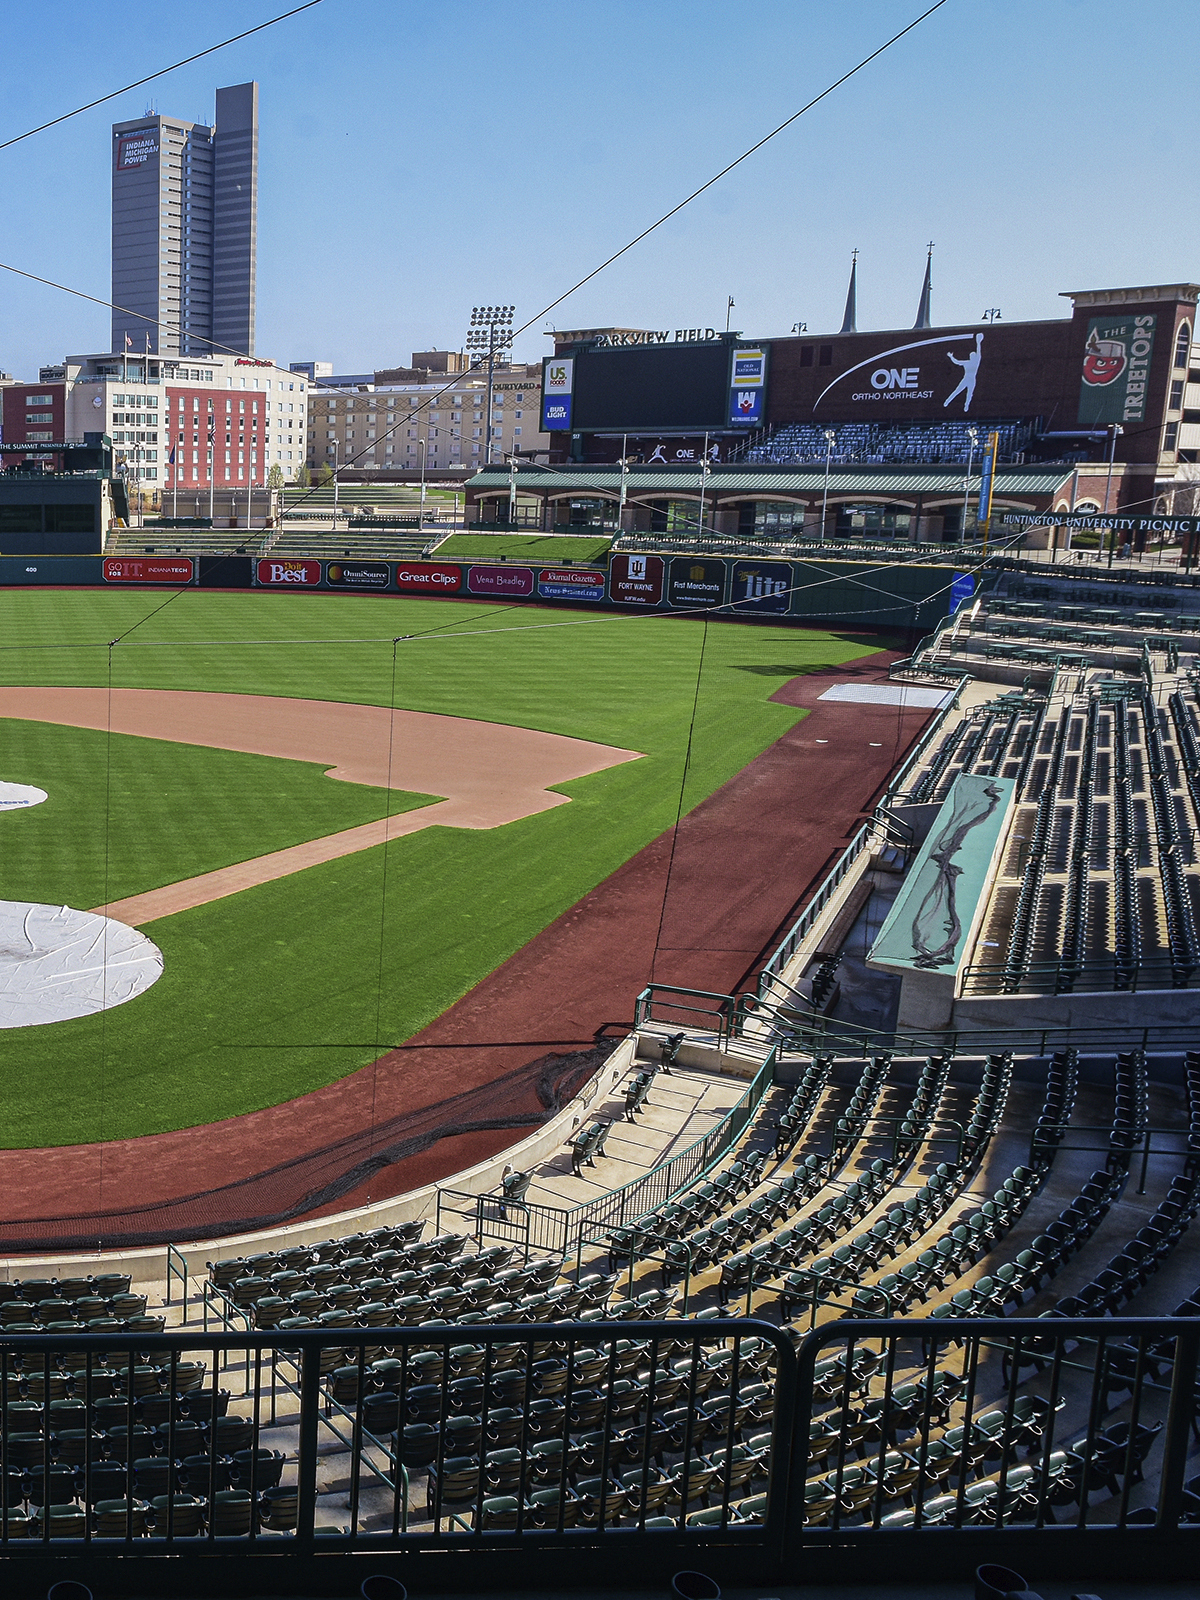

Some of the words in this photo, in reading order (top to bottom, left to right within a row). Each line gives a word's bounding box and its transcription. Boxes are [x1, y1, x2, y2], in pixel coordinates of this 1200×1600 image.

[126, 139, 155, 150] INDIANA
[125, 146, 159, 157] MICHIGAN
[124, 155, 148, 165] POWER
[1103, 325, 1127, 337] THE
[594, 331, 670, 347] PARKVIEW
[675, 328, 717, 342] FIELD
[1123, 315, 1154, 422] TREETOPS
[870, 367, 920, 390] ONE
[852, 392, 881, 401] ORTHO
[883, 390, 934, 400] NORTHEAST
[676, 449, 695, 458] ONE
[1004, 514, 1062, 526] HUNTINGTON
[1066, 518, 1135, 530] UNIVERSITY
[1140, 519, 1190, 532] PICNIC
[108, 562, 123, 571] GO
[270, 564, 307, 582] Best
[343, 569, 388, 578] OmniSource
[399, 571, 430, 583] Great
[432, 573, 456, 586] Clips
[548, 572, 570, 581] Journal
[571, 573, 596, 583] Gazette
[476, 575, 495, 585] Vera
[497, 576, 526, 588] Bradley
[618, 582, 633, 590] FORT
[634, 583, 653, 592] WAYNE
[673, 581, 686, 589] First
[686, 582, 720, 591] Merchants
